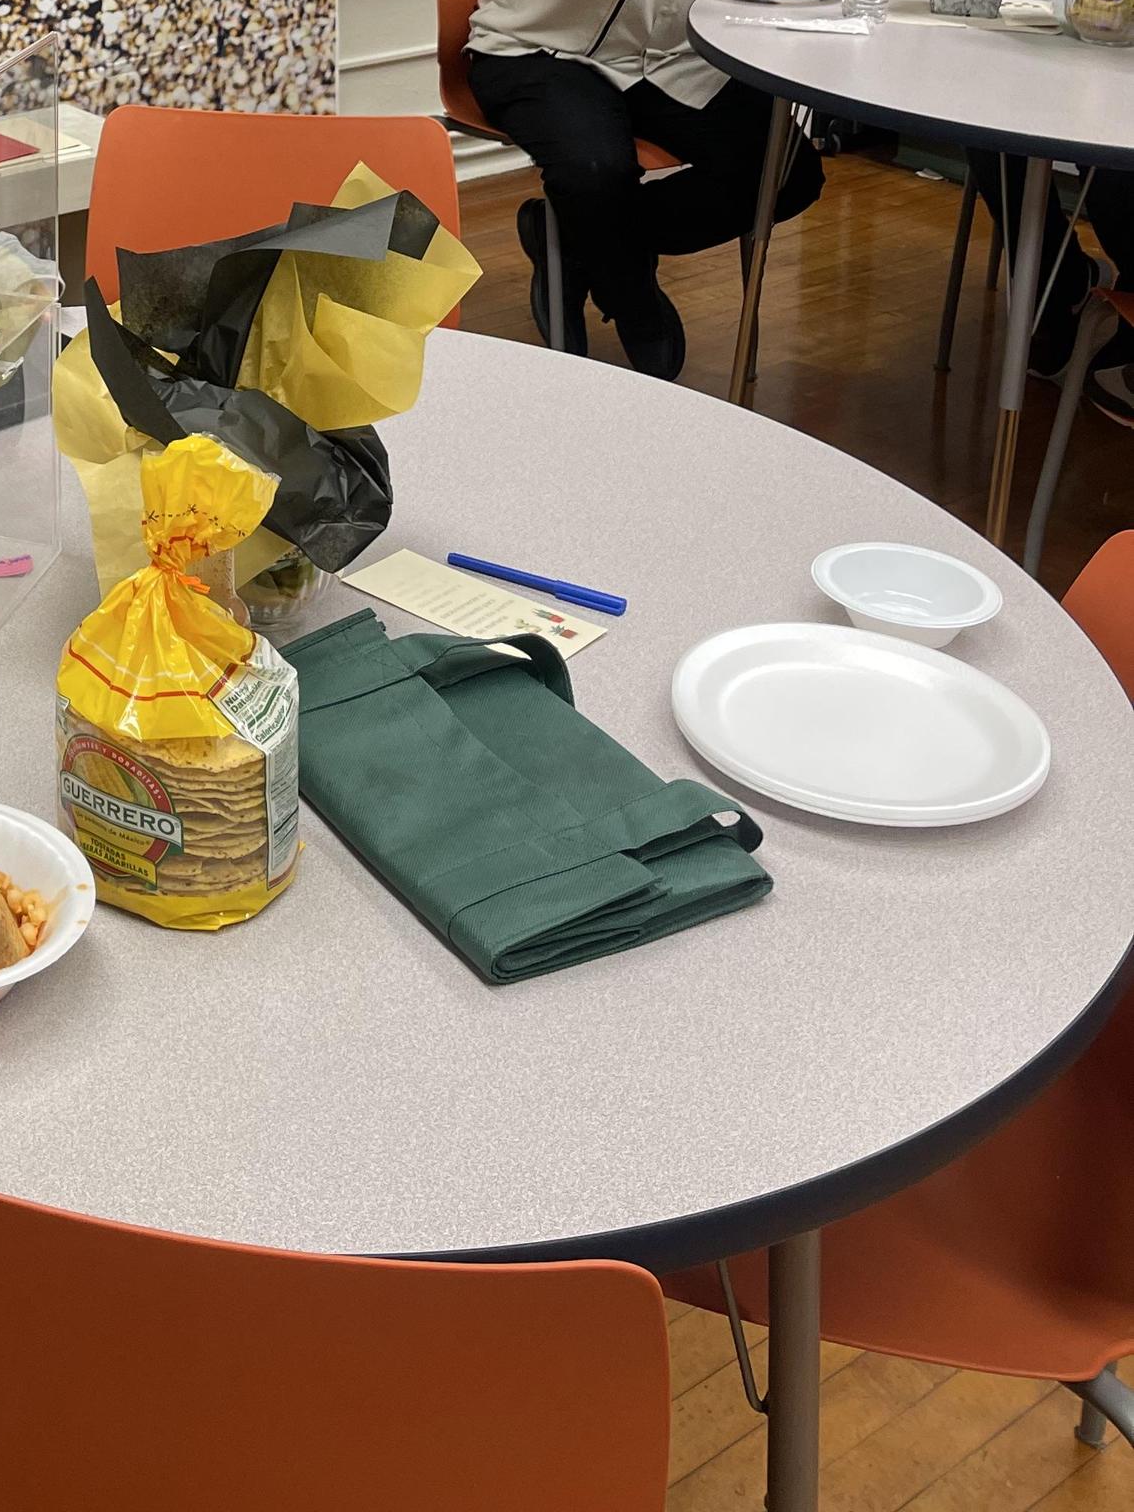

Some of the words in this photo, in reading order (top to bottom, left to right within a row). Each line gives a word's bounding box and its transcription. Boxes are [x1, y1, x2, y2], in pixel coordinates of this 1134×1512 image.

[63, 777, 175, 836] GUERRERO
[90, 838, 126, 860] TOSTADAS
[104, 850, 148, 877] AMARILLAS
